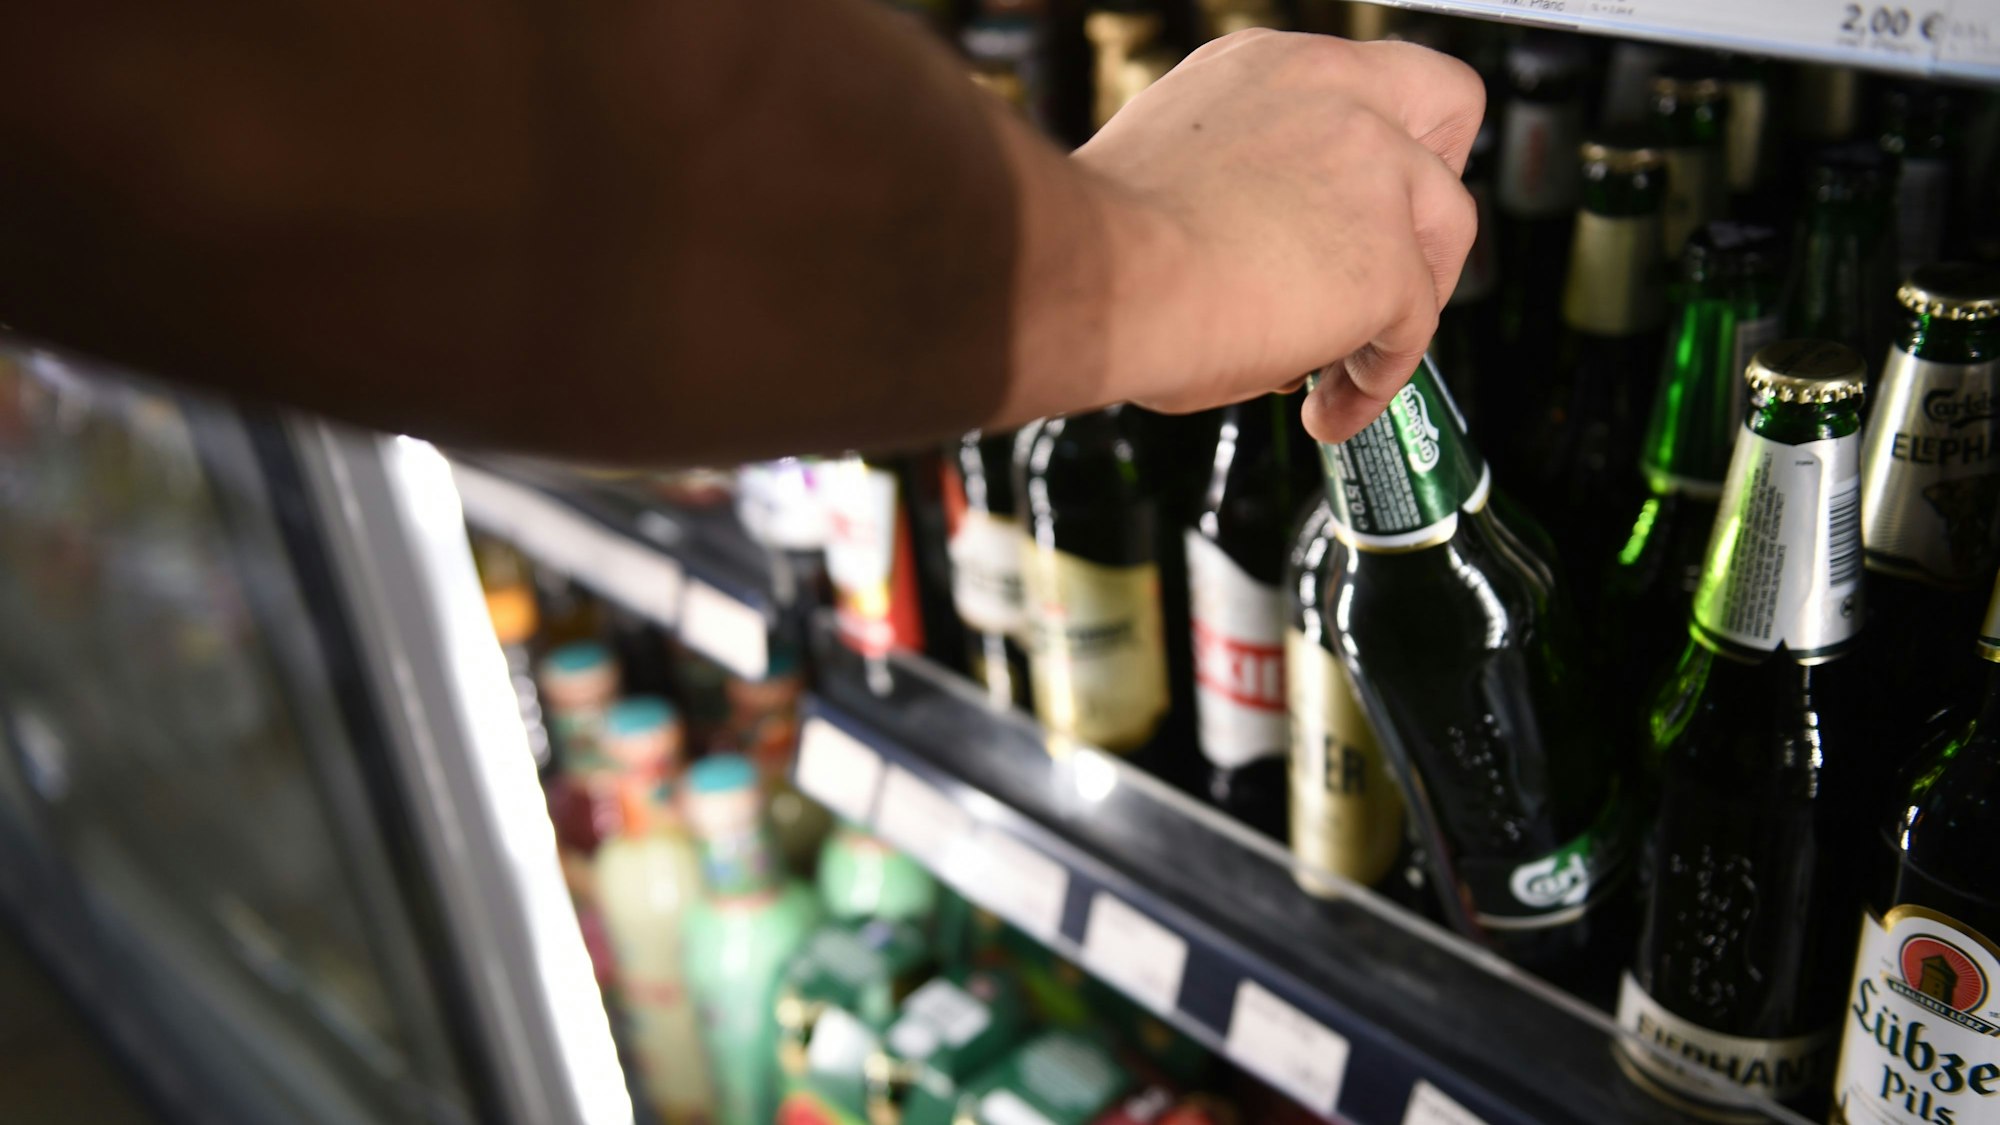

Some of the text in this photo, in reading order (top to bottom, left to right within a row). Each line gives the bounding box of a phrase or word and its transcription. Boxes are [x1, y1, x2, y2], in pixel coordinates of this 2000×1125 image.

[1840, 3, 1912, 38] 2,00
[1401, 383, 1440, 474] Carlsberg
[1852, 978, 2000, 1096] Lübze
[1880, 1063, 1955, 1125] Pils
